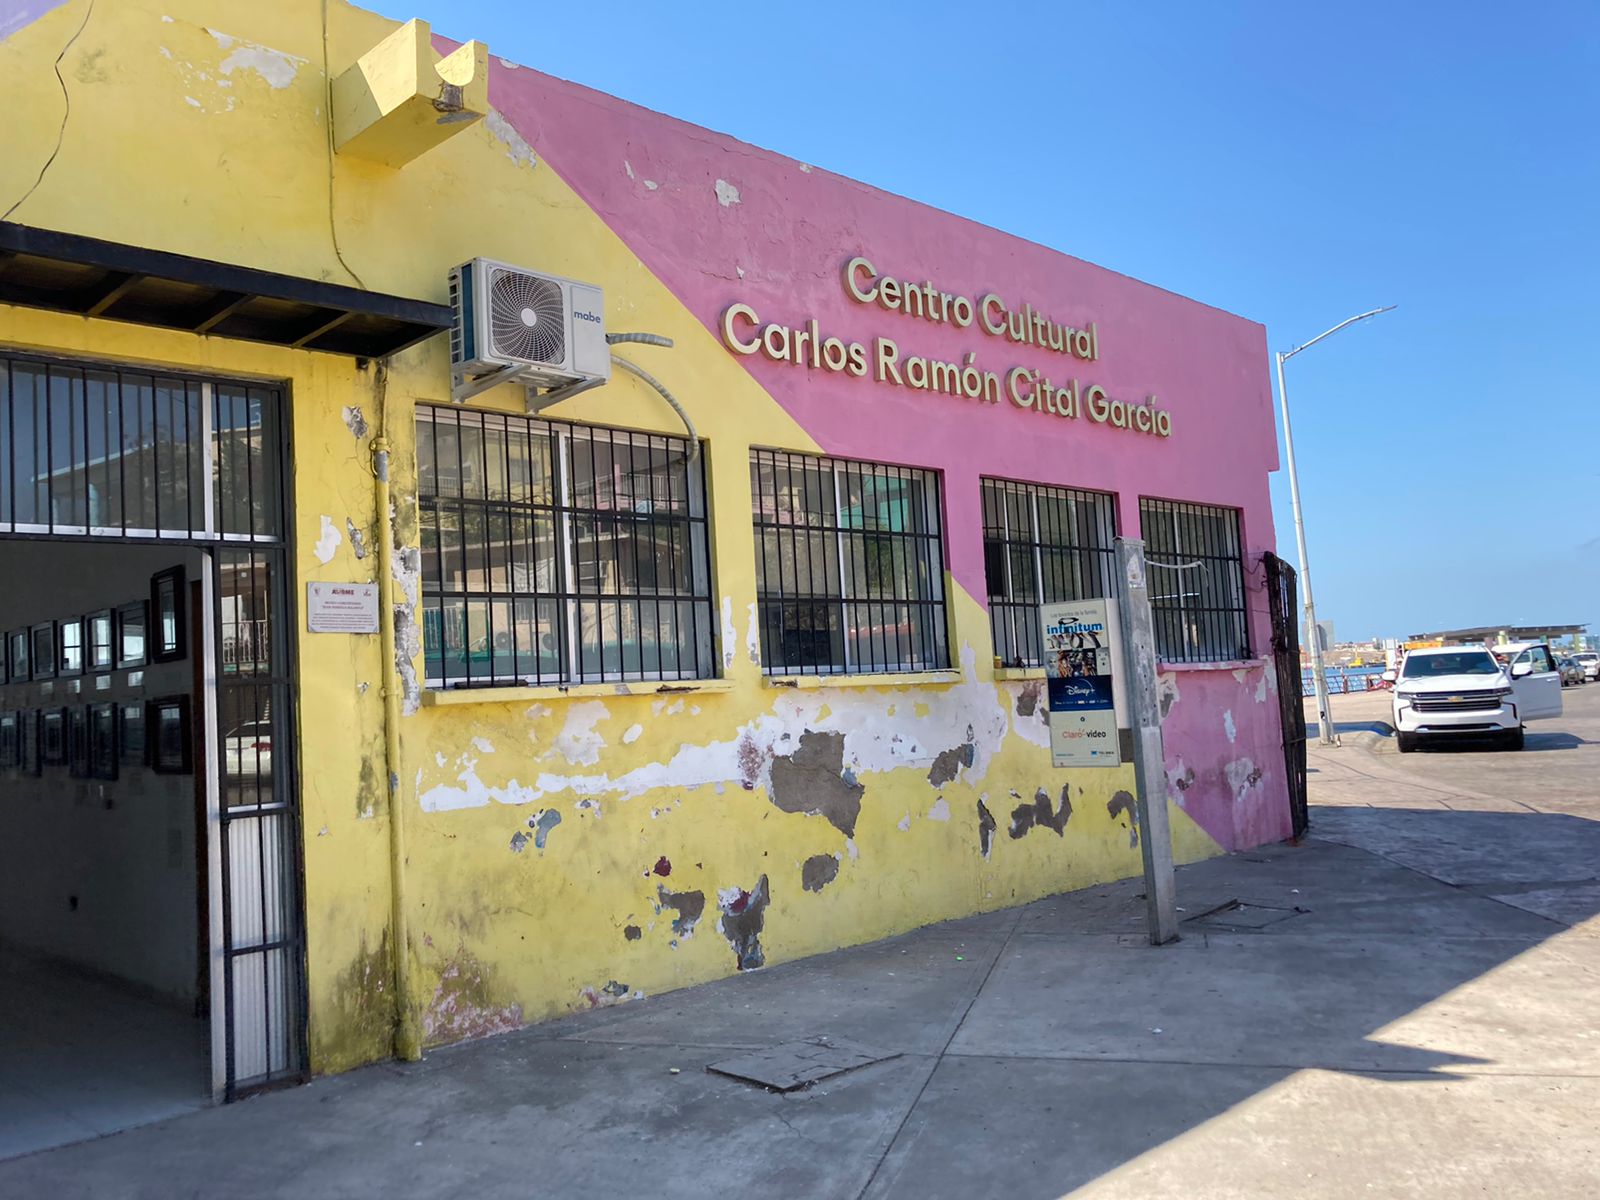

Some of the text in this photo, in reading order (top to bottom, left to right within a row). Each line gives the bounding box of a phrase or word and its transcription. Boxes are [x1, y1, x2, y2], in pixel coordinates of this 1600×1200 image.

[574, 311, 601, 324] mabe
[842, 256, 1099, 361] Centro Cultural
[720, 303, 1173, 437] Carlos Ramón Cital García
[1086, 729, 1107, 738] video
